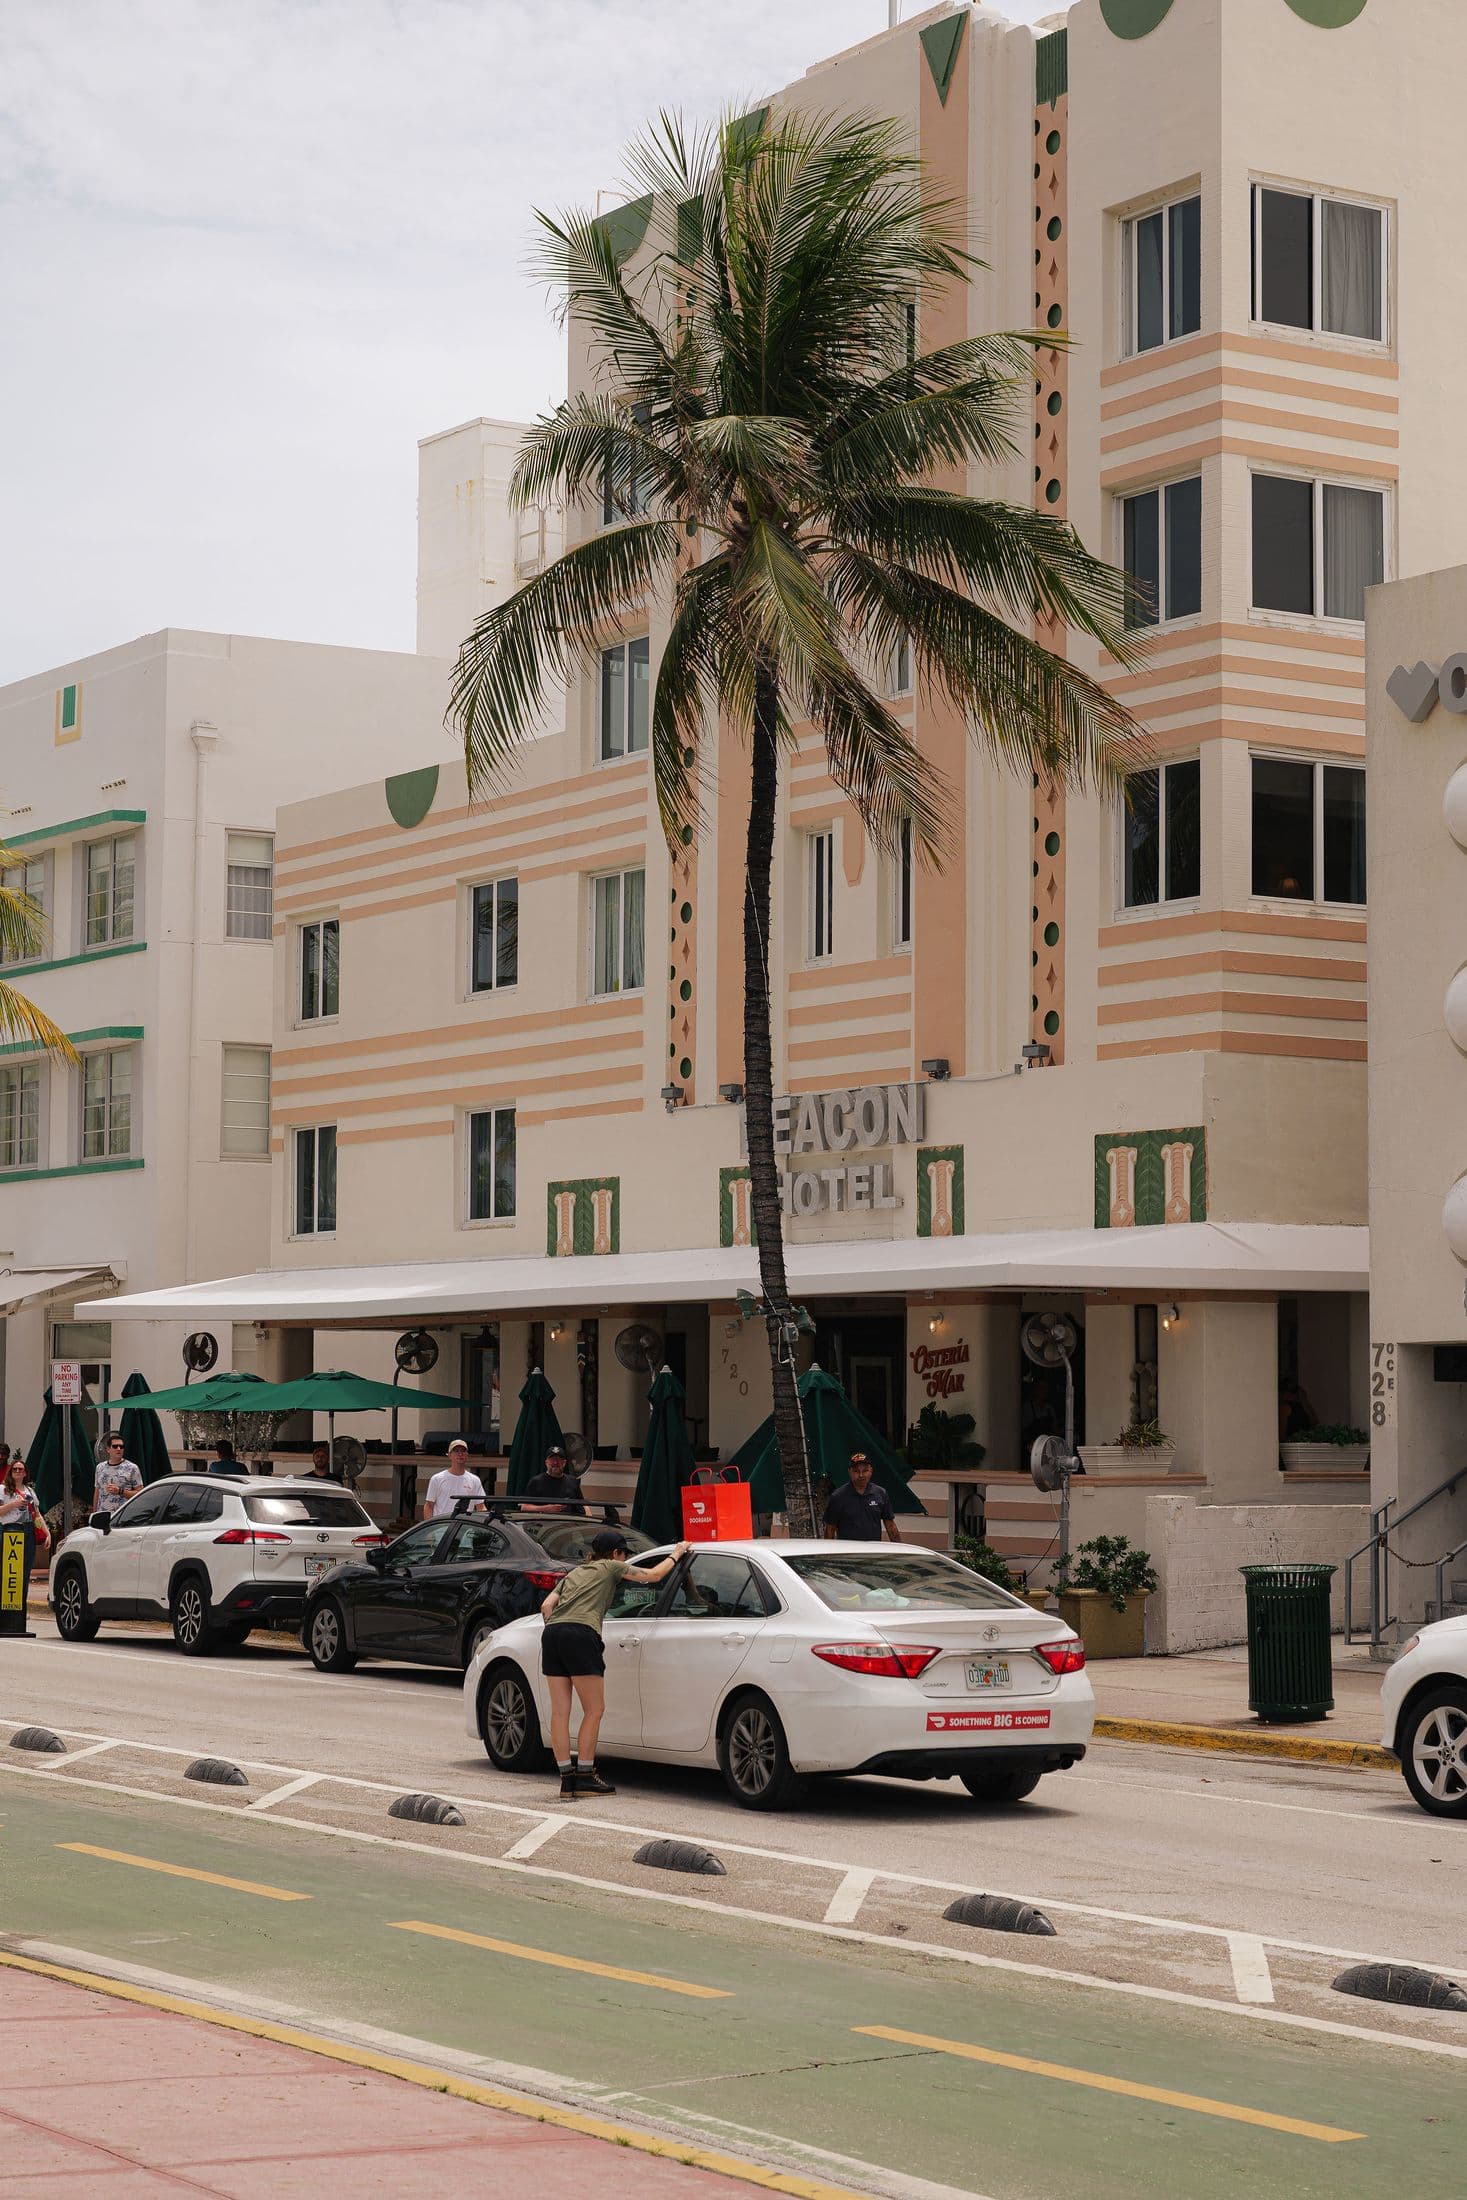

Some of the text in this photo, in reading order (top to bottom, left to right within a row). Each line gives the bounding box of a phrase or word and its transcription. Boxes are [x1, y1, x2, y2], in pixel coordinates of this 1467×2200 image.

[740, 1084, 926, 1159] EACON
[949, 1714, 1049, 1728] SOMETHING BIG IS COMING
